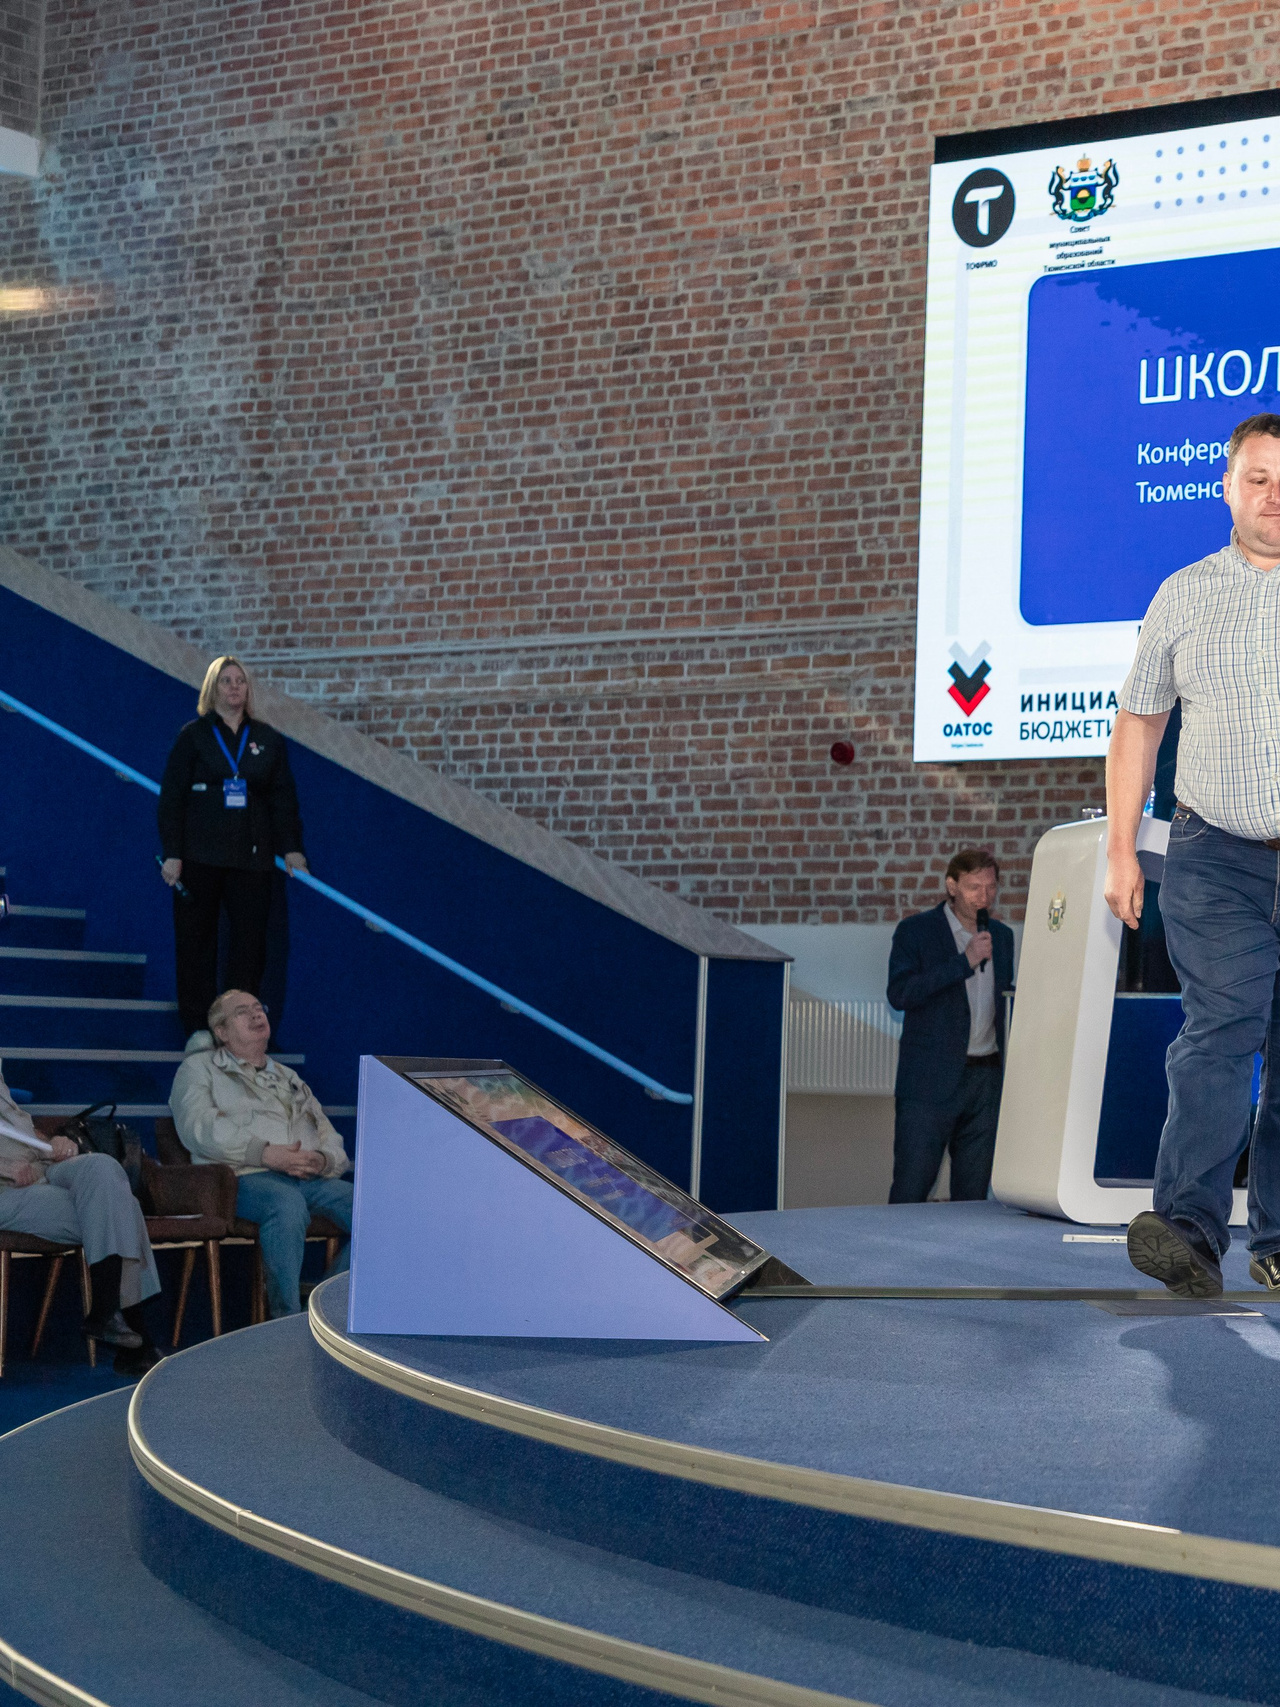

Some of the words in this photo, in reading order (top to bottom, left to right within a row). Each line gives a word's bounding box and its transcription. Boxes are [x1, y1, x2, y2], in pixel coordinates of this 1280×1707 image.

[1048, 235, 1111, 249] муниципальных
[1056, 246, 1103, 260] образований
[1043, 260, 1085, 272] Тюменской
[1087, 259, 1116, 268] области
[1137, 438, 1230, 466] Конфере
[1136, 480, 1223, 504] Тюменс
[1020, 690, 1119, 713] ИНИЦИА
[943, 722, 993, 737] ОАТОС
